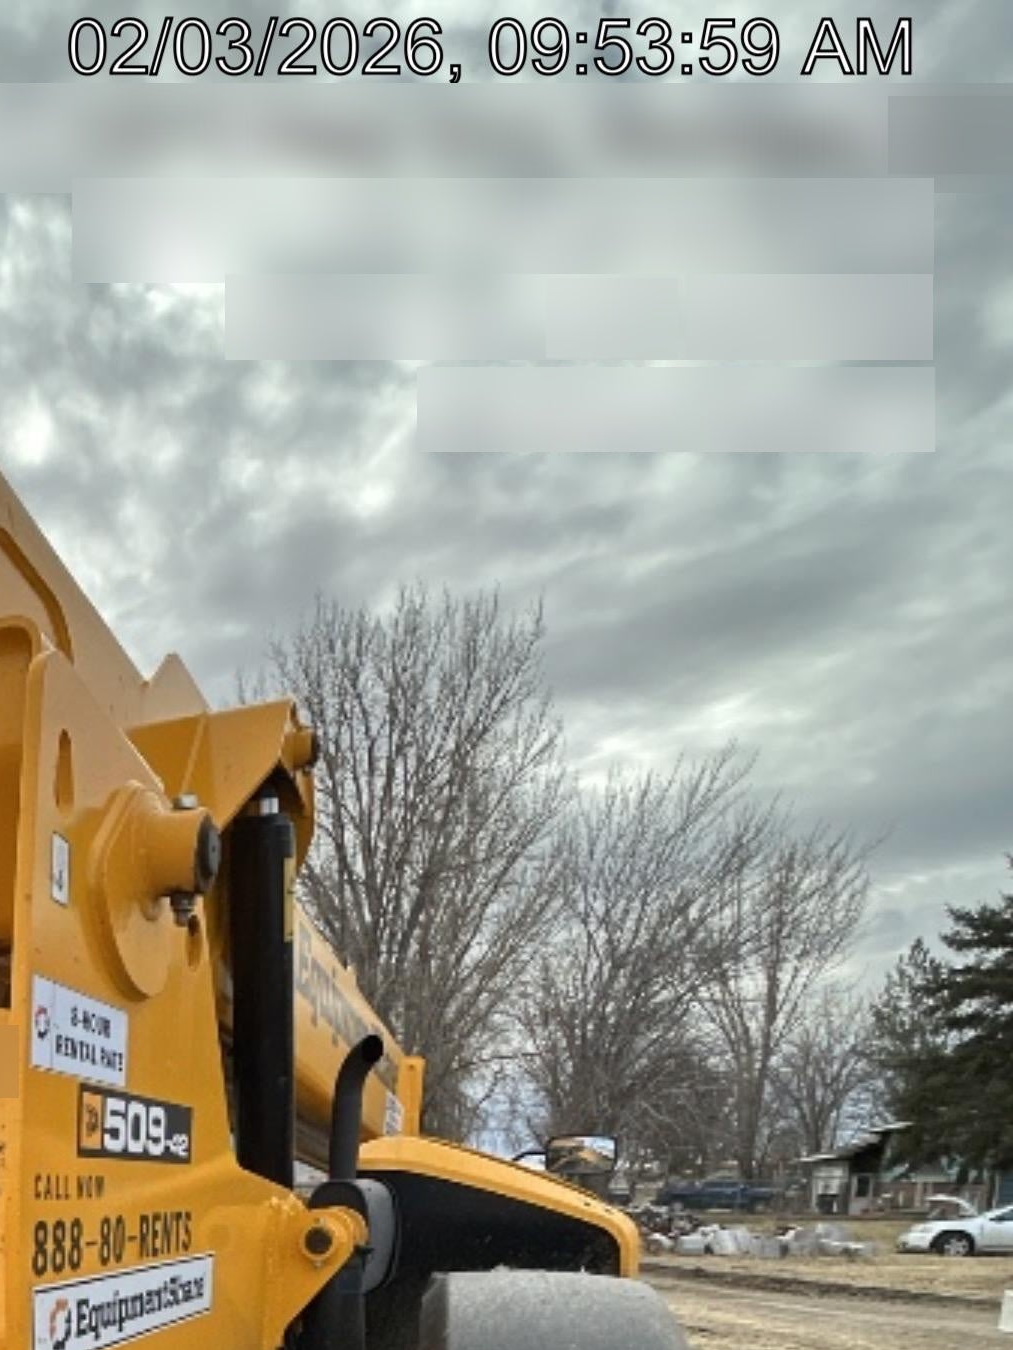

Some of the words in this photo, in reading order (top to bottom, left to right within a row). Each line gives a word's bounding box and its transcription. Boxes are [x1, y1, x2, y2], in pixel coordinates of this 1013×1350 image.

[55, 1034, 97, 1066] RENTAL
[34, 1173, 69, 1200] CALL
[77, 1175, 105, 1200] NOW
[32, 1211, 192, 1276] 888-80-RENTS
